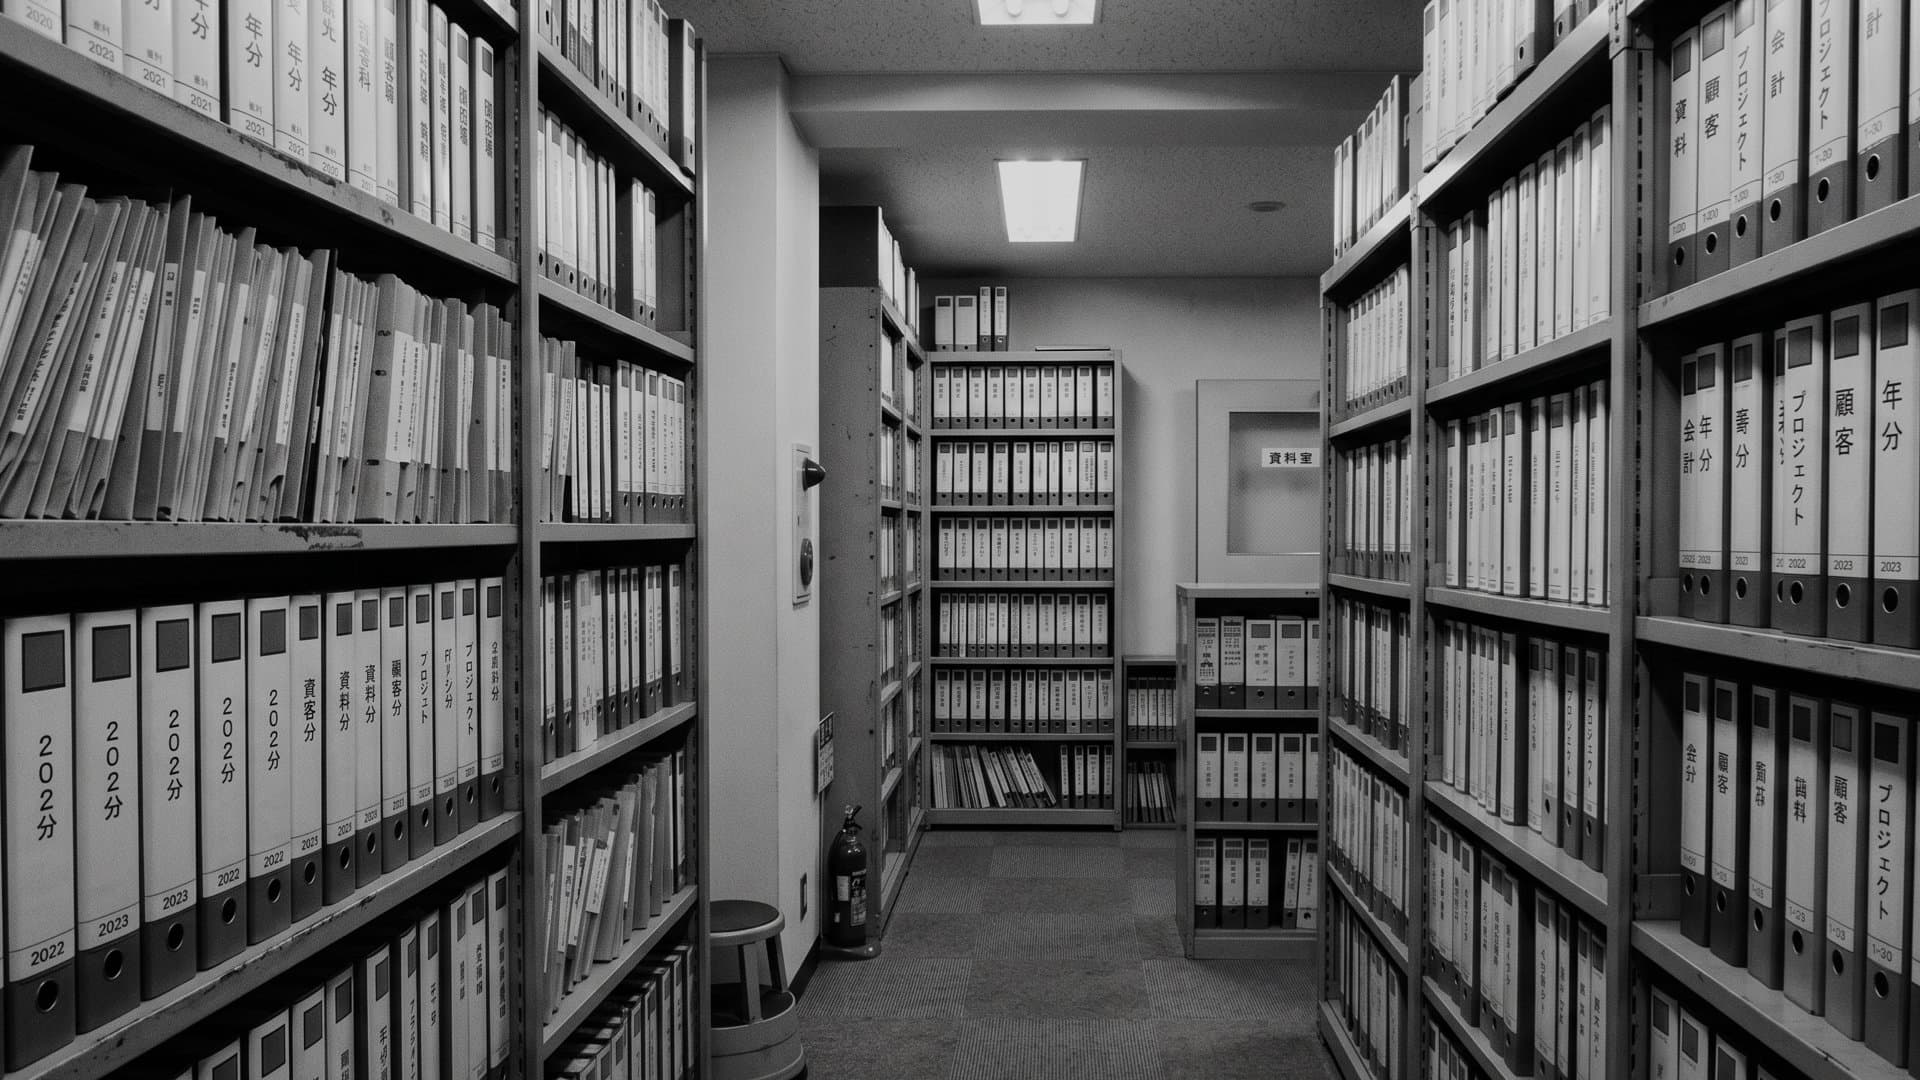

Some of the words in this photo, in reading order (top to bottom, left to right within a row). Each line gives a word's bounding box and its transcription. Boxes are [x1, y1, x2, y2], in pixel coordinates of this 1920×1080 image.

[245, 13, 263, 68] 年分
[287, 41, 303, 92] 年分
[143, 68, 166, 88] 2021
[190, 94, 212, 113] 2021
[321, 66, 337, 116] 年分
[245, 119, 266, 137] 2021
[1704, 76, 1720, 141] 顧客
[1738, 45, 1750, 171] プロジェクト
[1699, 414, 1713, 472] 年分
[1835, 388, 1855, 456] 顧客
[1881, 380, 1903, 452] 年分
[1269, 452, 1313, 465] 資料室
[1683, 419, 1695, 474] 会計
[1792, 389, 1808, 526] プロジェクト
[1788, 558, 1807, 569] 2022
[1833, 559, 1853, 571] 2023
[1880, 561, 1902, 574] 2023
[339, 671, 350, 731] 資料分
[365, 664, 376, 723] 資料分
[465, 641, 474, 736] プロジェクト
[167, 709, 183, 801] 202分
[221, 697, 236, 784] 202分
[268, 689, 281, 771] 202分
[37, 735, 57, 841] 202分
[104, 721, 123, 820] 202分
[1834, 775, 1849, 825] 顧客
[218, 868, 240, 887] 2022
[264, 850, 284, 868] 2022
[1878, 783, 1894, 921] プロジェクト
[99, 914, 129, 938] 2023
[163, 889, 189, 911] 2023
[31, 941, 65, 967] 2022
